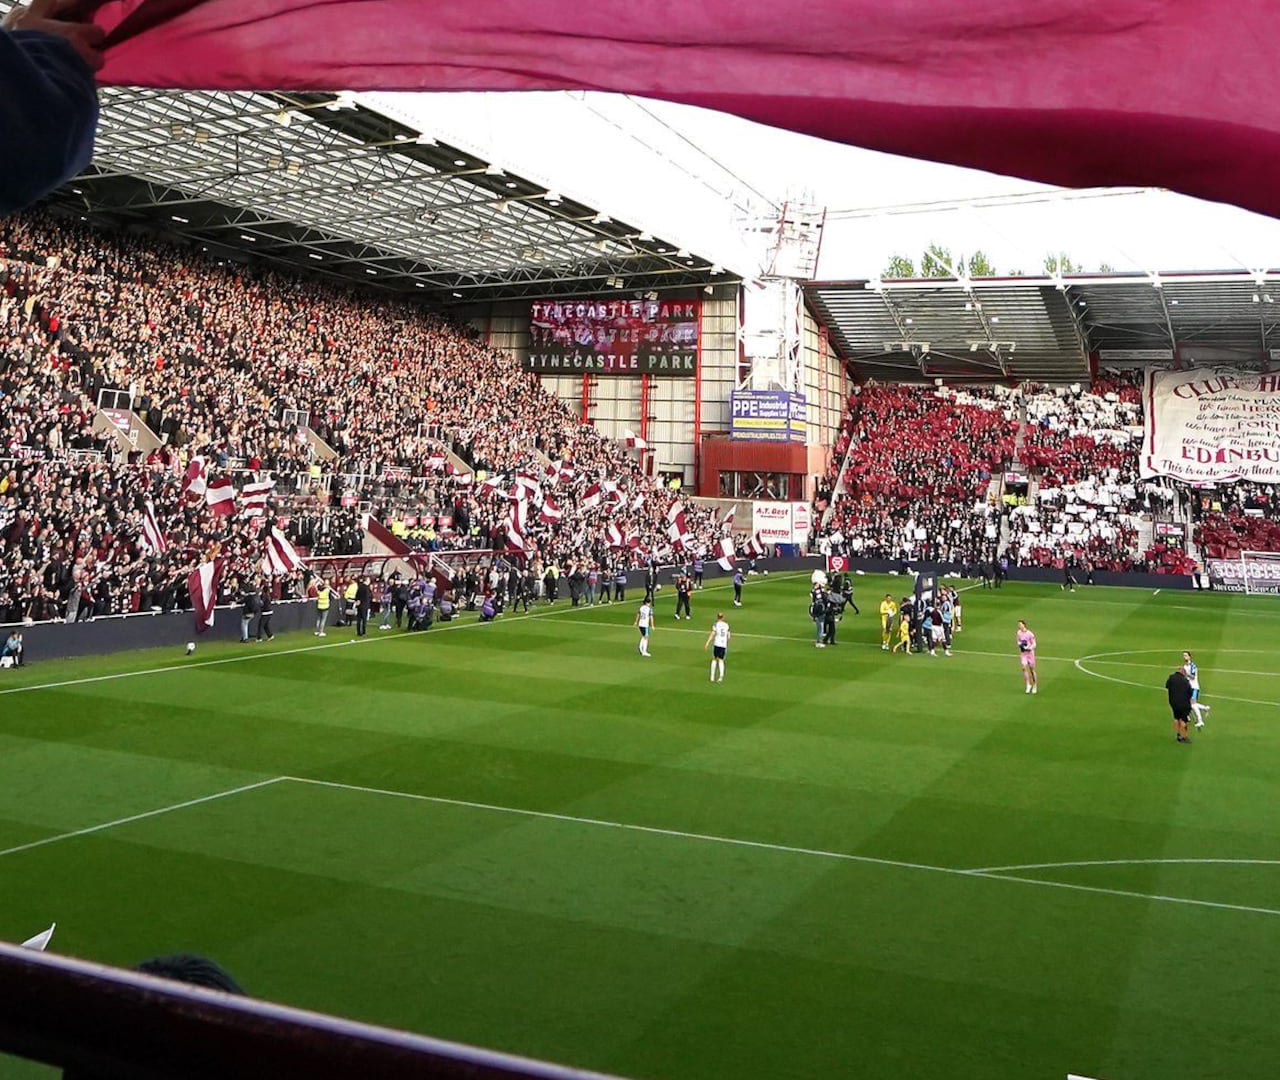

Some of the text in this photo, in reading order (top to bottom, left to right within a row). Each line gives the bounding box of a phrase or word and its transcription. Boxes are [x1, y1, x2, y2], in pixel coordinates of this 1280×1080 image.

[532, 303, 694, 319] TYNECASTLE PARK
[528, 354, 694, 369] TYNECASTLE PARK
[1173, 376, 1239, 399] CLUB
[733, 400, 759, 417] PPE
[1199, 402, 1214, 412] We
[1185, 422, 1202, 431] We
[1203, 422, 1227, 433] have
[1182, 437, 1198, 445] We
[1248, 438, 1276, 447] heart
[1160, 458, 1183, 474] This
[1251, 465, 1276, 476] that
[771, 507, 789, 516] Best
[761, 528, 790, 537] MANITOU
[1270, 584, 1279, 594] of
